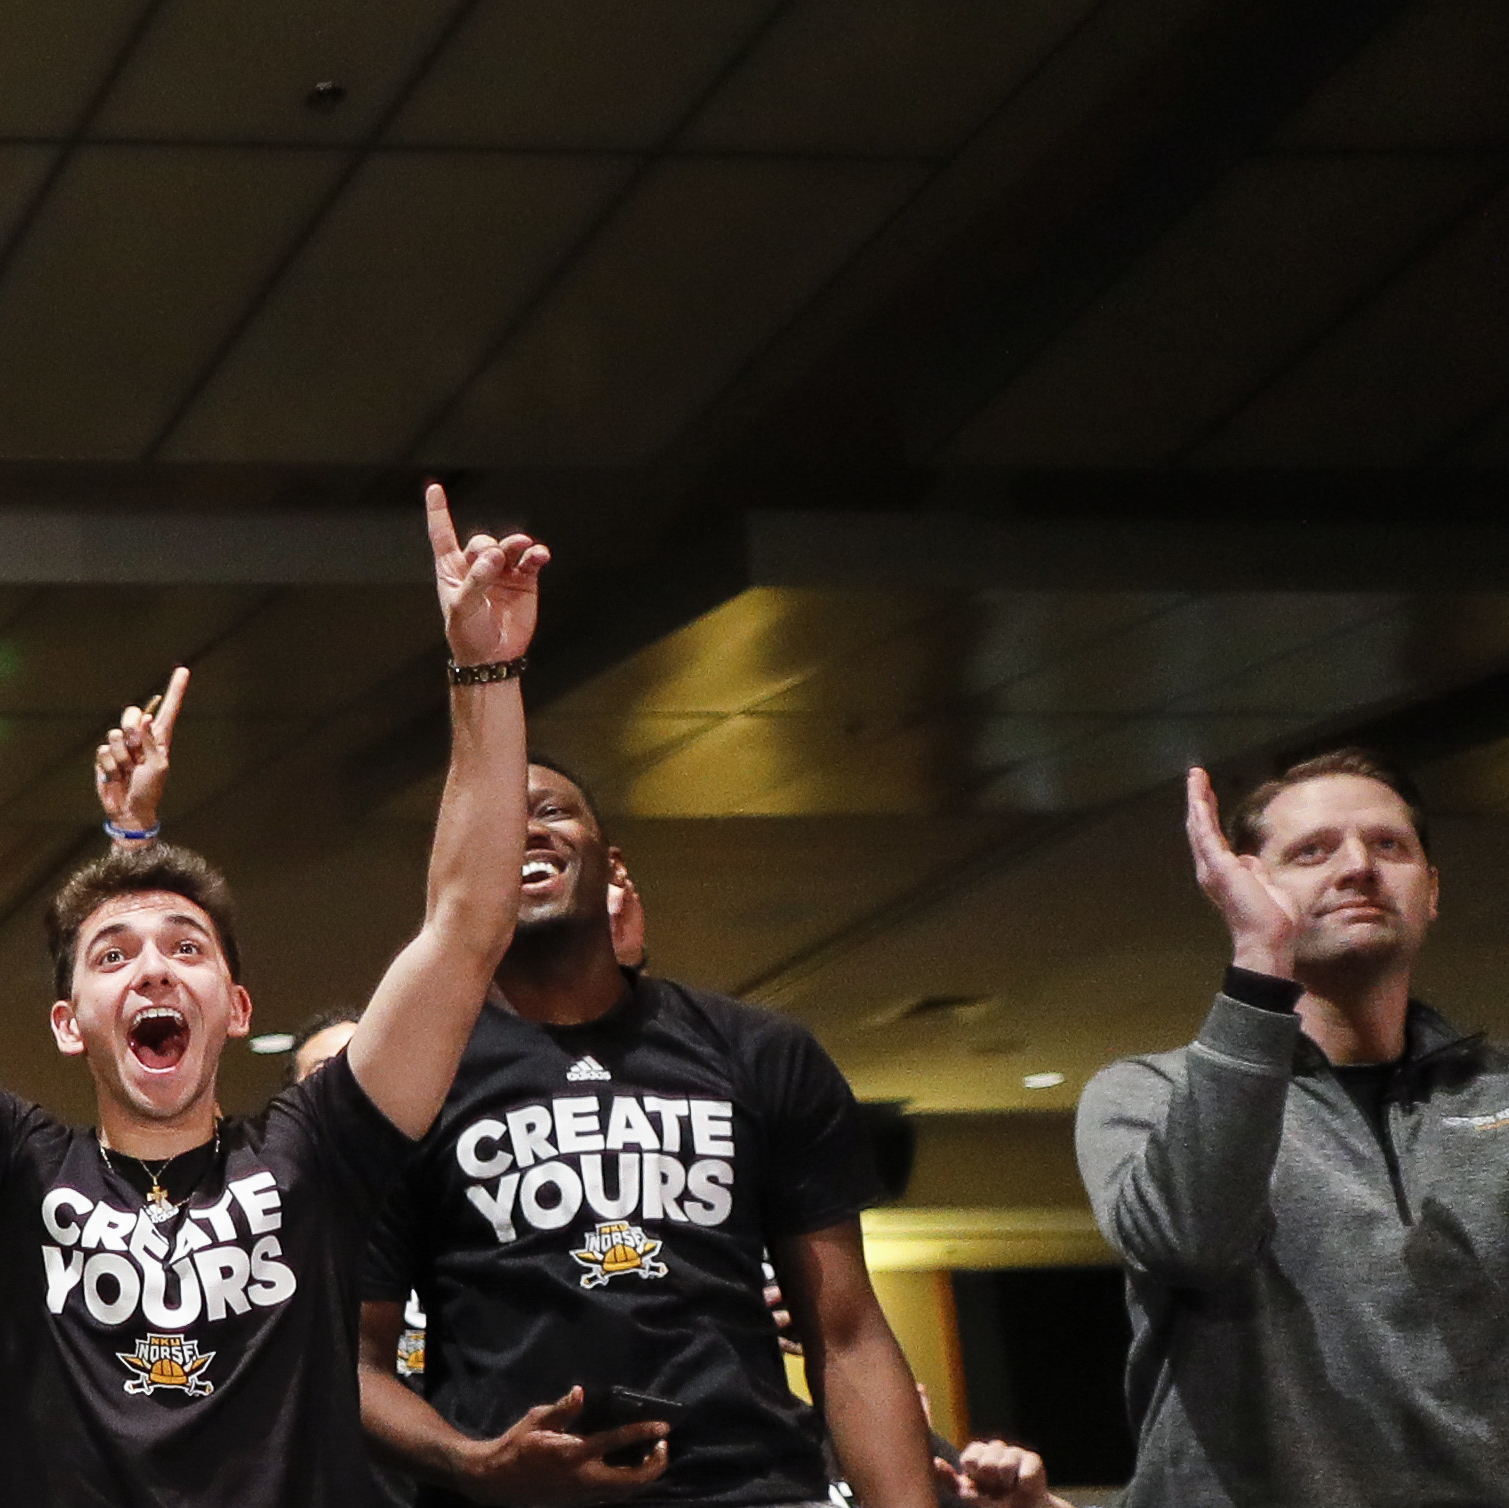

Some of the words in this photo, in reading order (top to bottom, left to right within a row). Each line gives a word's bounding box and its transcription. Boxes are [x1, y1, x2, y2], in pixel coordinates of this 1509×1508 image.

[456, 1096, 735, 1179] CREATE
[42, 1171, 282, 1265] CREATE
[465, 1152, 734, 1243] YOURS
[41, 1235, 297, 1328] YOURS
[138, 1345, 195, 1363] NORSE
[151, 1337, 180, 1346] NKU
